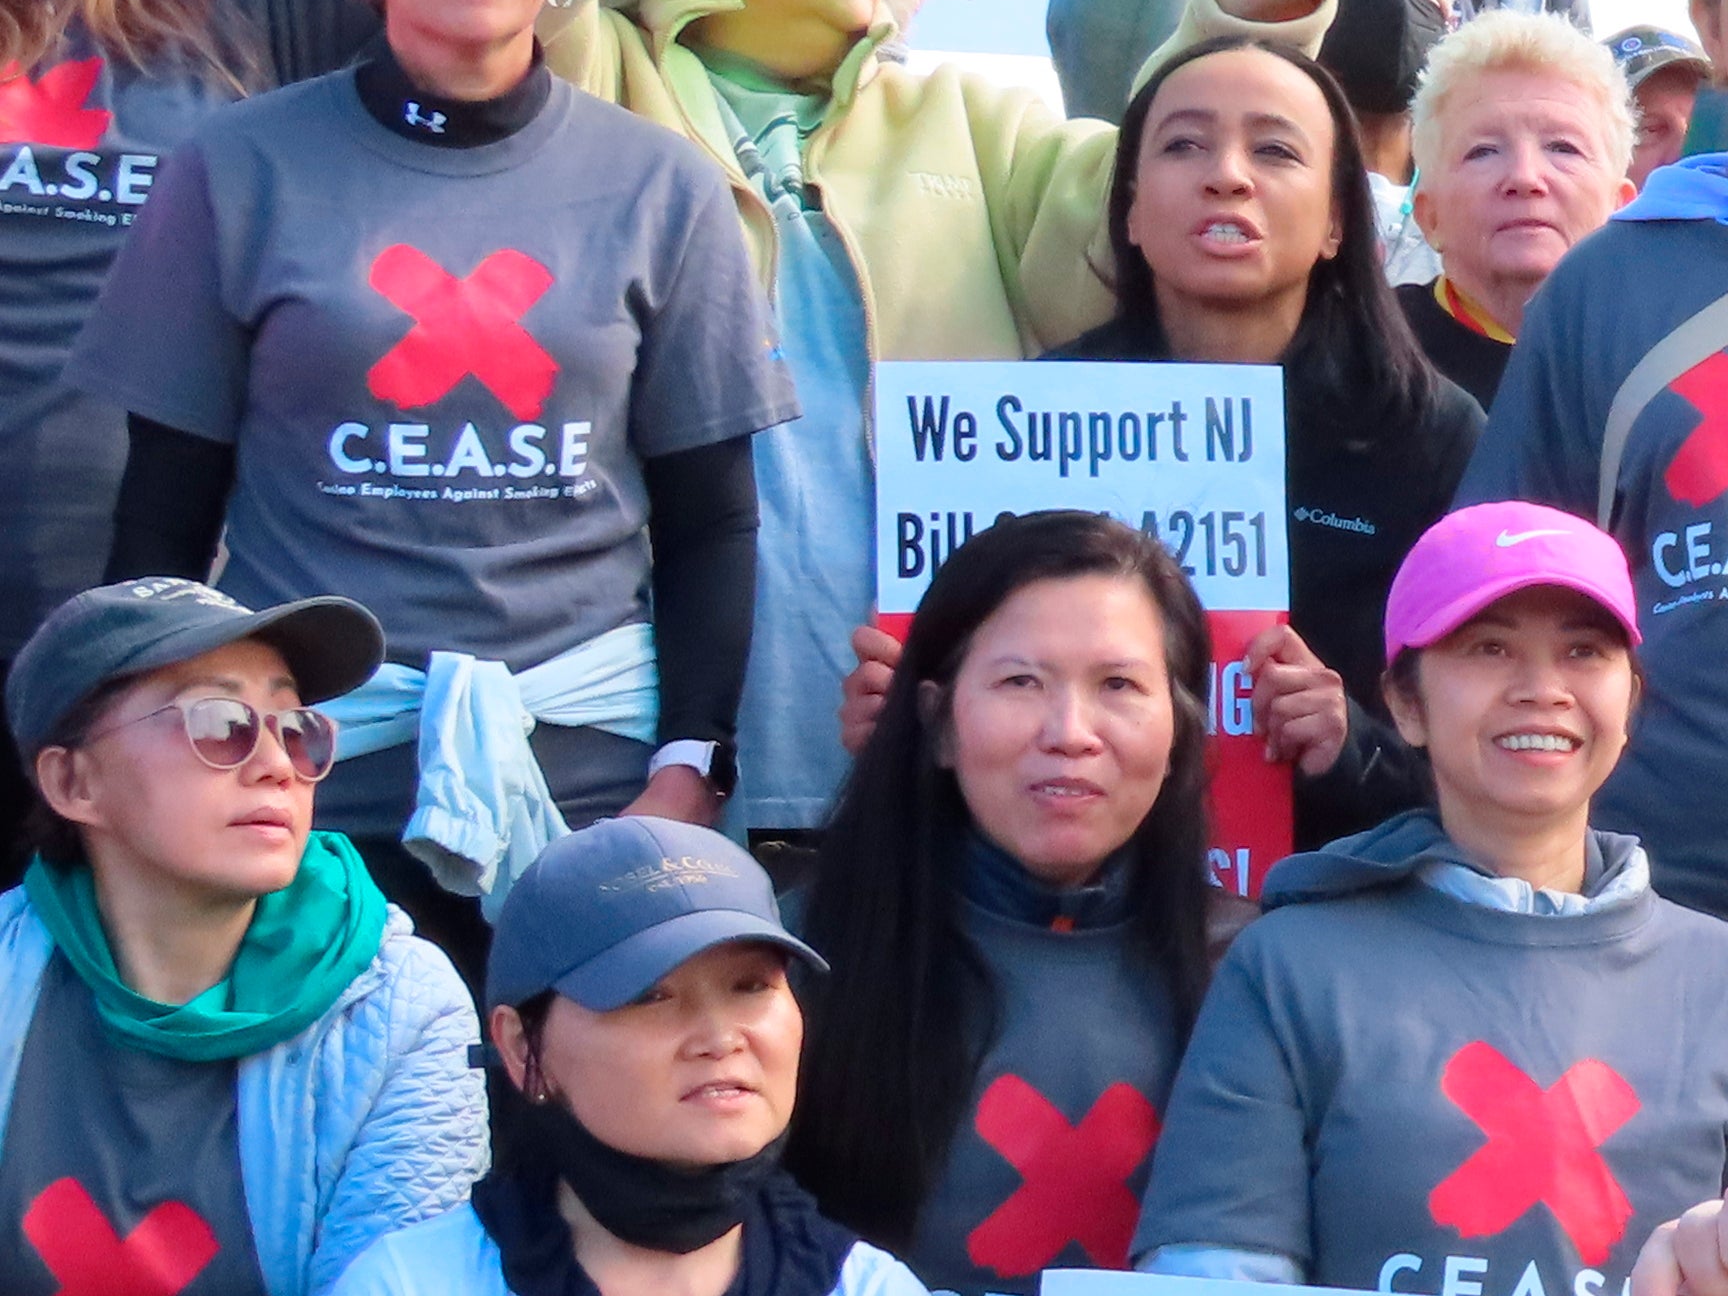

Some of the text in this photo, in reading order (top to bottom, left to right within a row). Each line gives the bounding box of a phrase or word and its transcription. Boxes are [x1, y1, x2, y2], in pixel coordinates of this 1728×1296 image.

[329, 421, 592, 478] C.E.A.S.E
[907, 395, 1254, 478] We Support NJ
[443, 487, 499, 502] Against
[1309, 508, 1376, 535] Columbia
